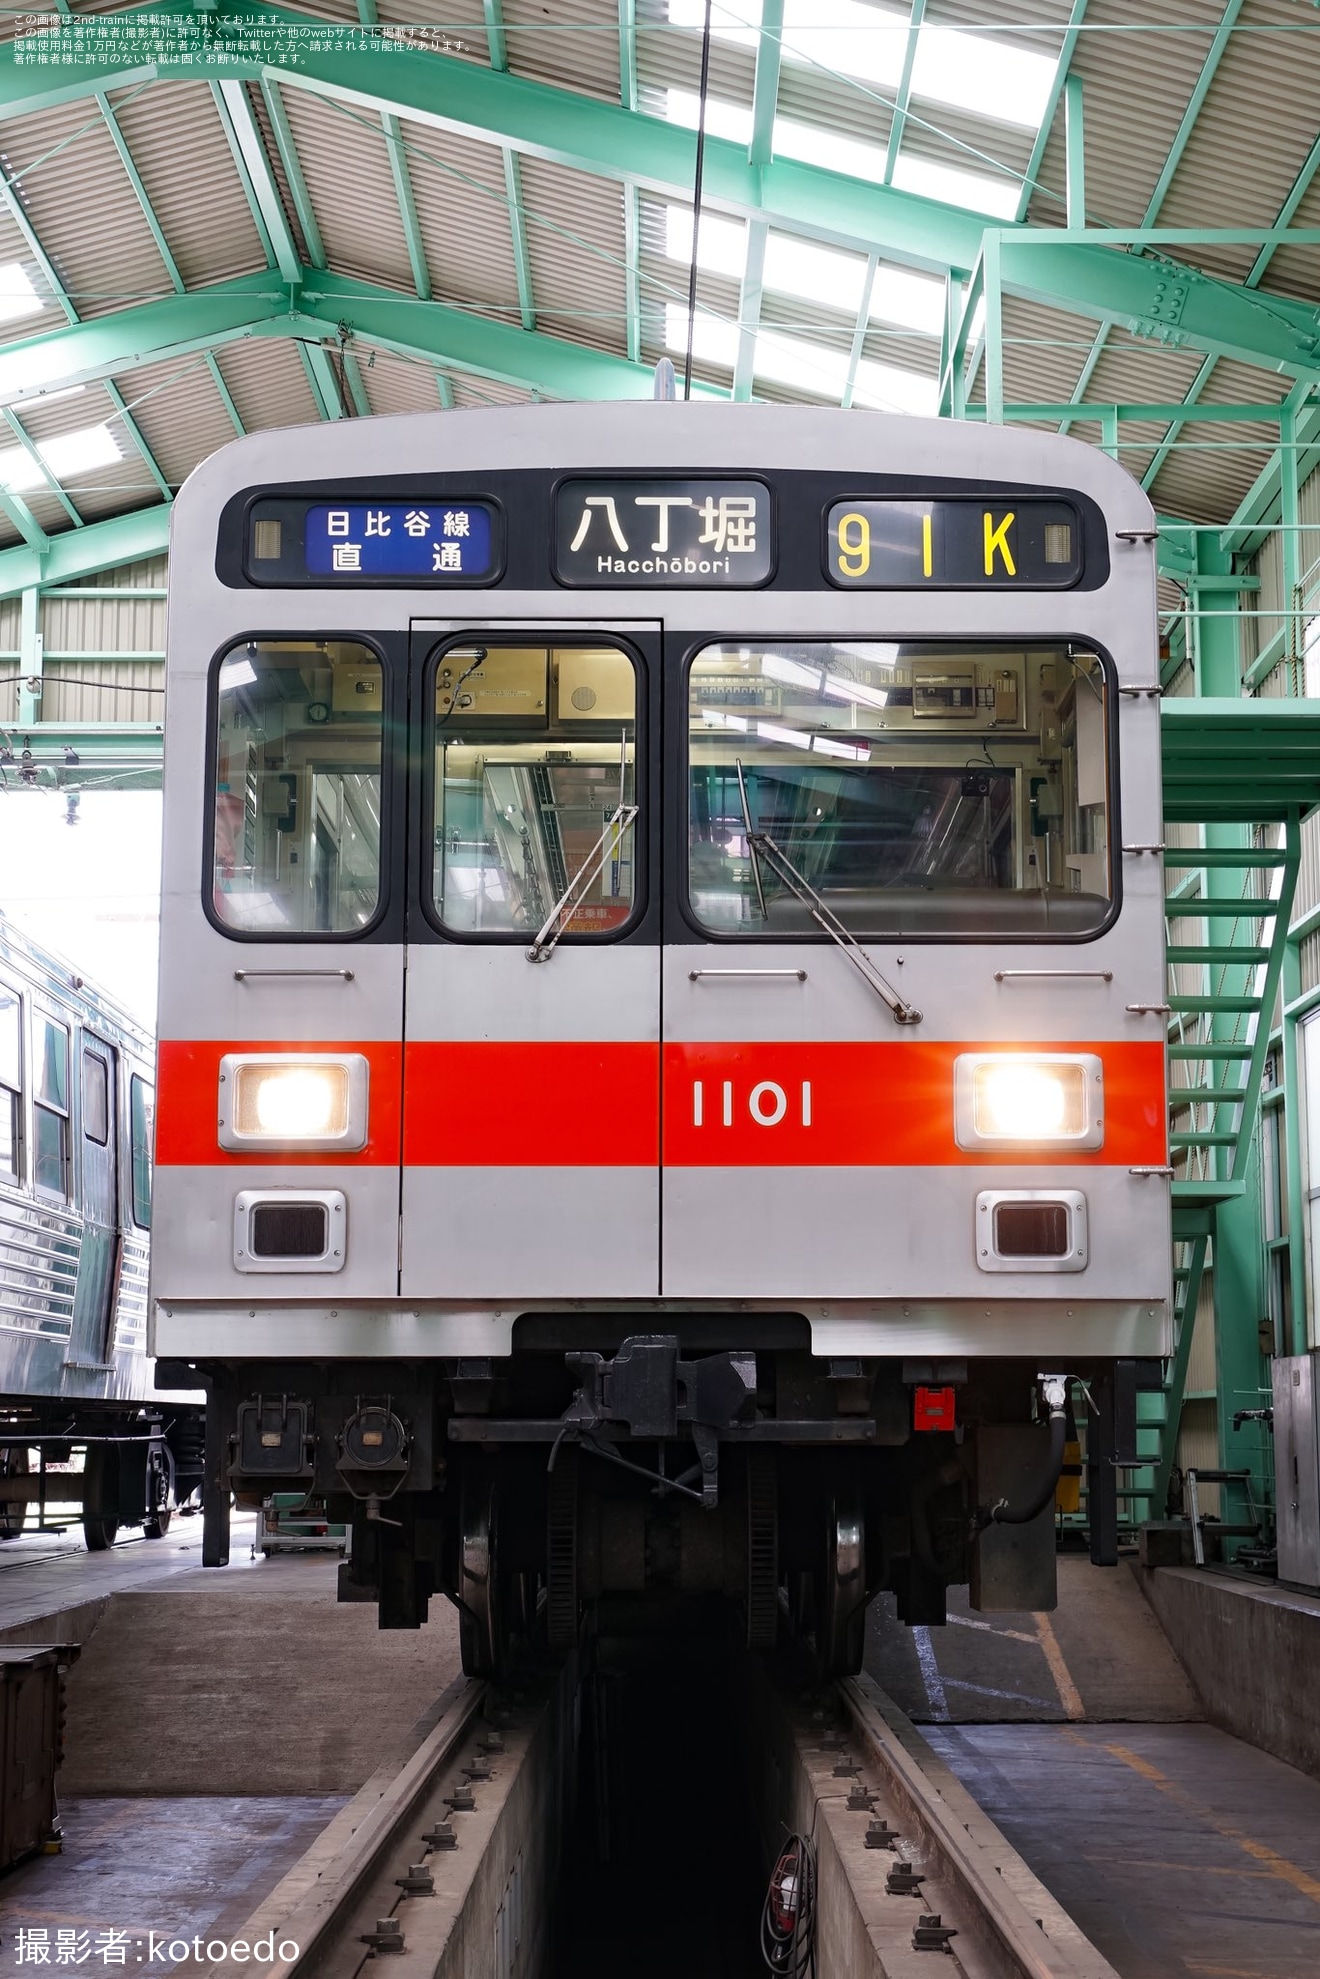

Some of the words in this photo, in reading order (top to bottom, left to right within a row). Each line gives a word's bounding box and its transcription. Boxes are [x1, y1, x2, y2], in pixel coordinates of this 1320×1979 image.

[327, 510, 470, 537] 日比谷線
[570, 496, 756, 553] 八丁堀
[597, 555, 730, 574] Hacchōbori
[693, 1081, 811, 1126] 1101
